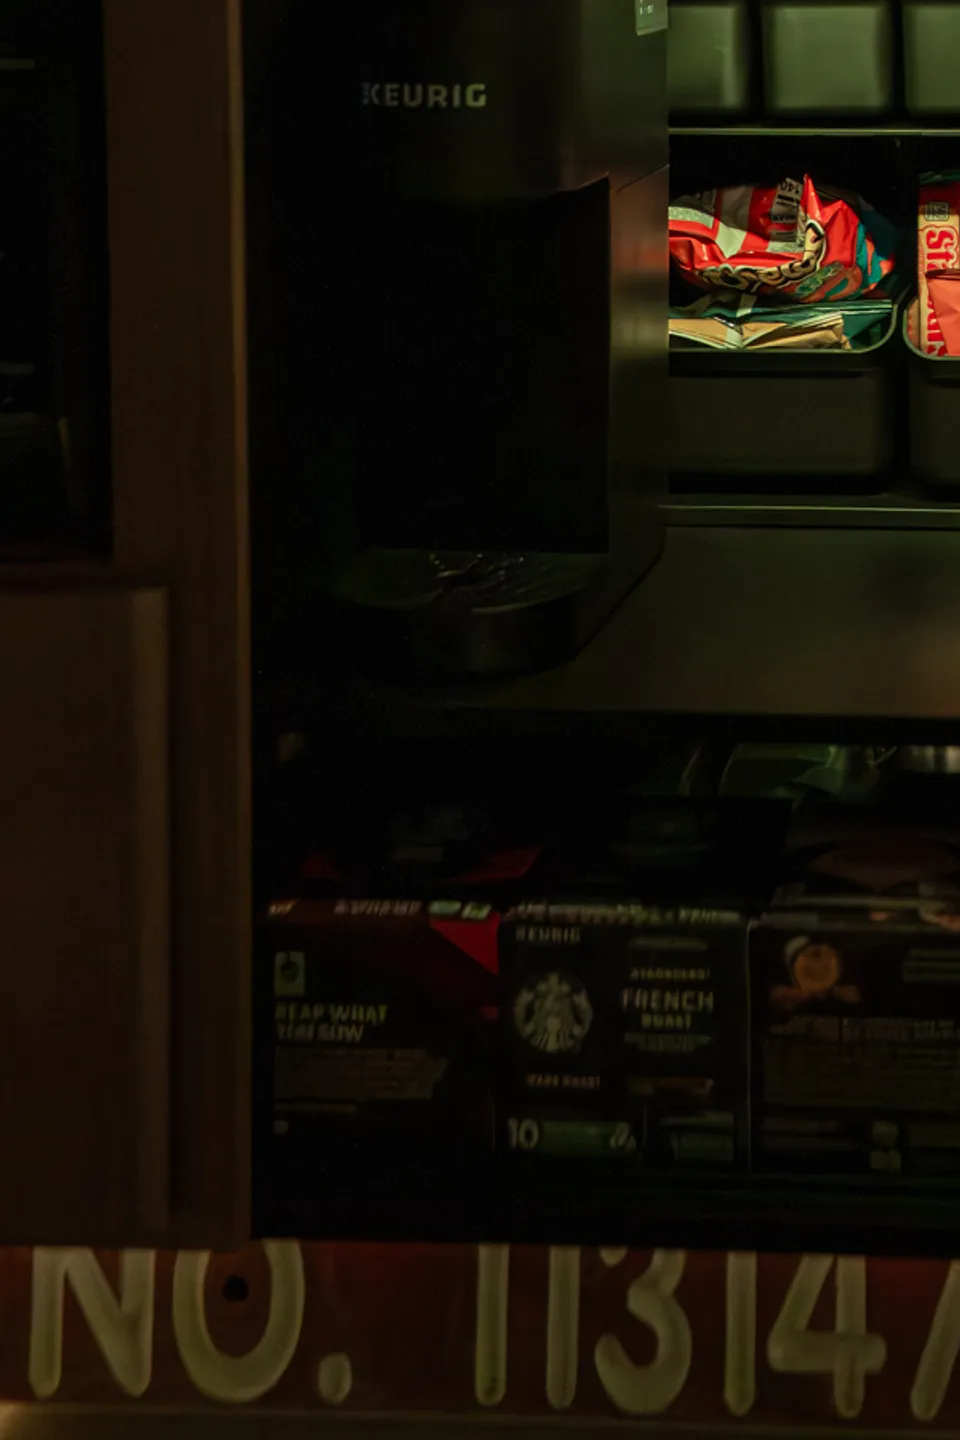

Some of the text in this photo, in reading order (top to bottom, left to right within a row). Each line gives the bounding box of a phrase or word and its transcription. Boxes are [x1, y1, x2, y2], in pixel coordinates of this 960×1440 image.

[360, 81, 488, 109] KEURIG
[329, 1002, 390, 1024] WHAT
[621, 986, 714, 1014] FRENCH
[507, 1116, 540, 1150] 10
[27, 1240, 354, 1405] NO.
